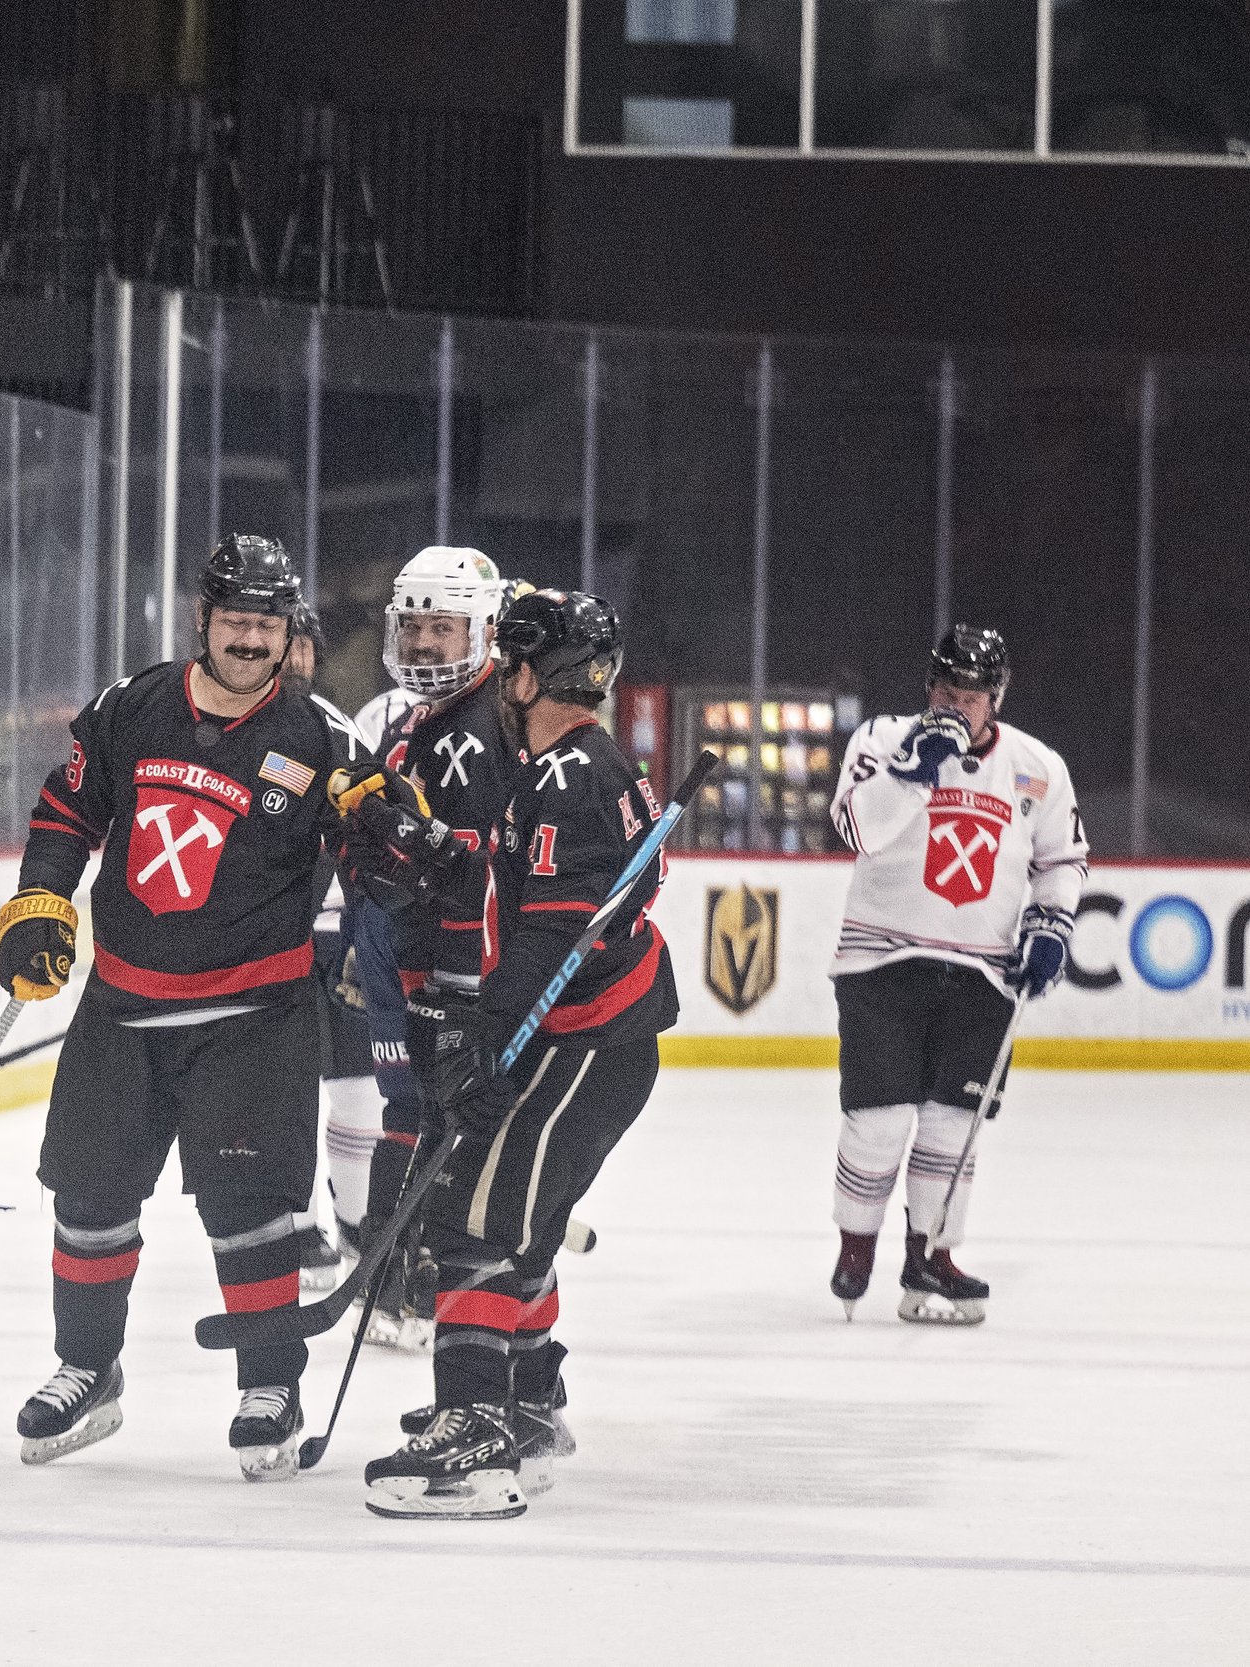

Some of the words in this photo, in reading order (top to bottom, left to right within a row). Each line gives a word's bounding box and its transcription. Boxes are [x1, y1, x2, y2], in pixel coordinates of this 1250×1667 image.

[146, 764, 186, 779] COAST
[203, 776, 242, 799] COAST
[265, 791, 284, 806] CV
[528, 823, 558, 876] 1
